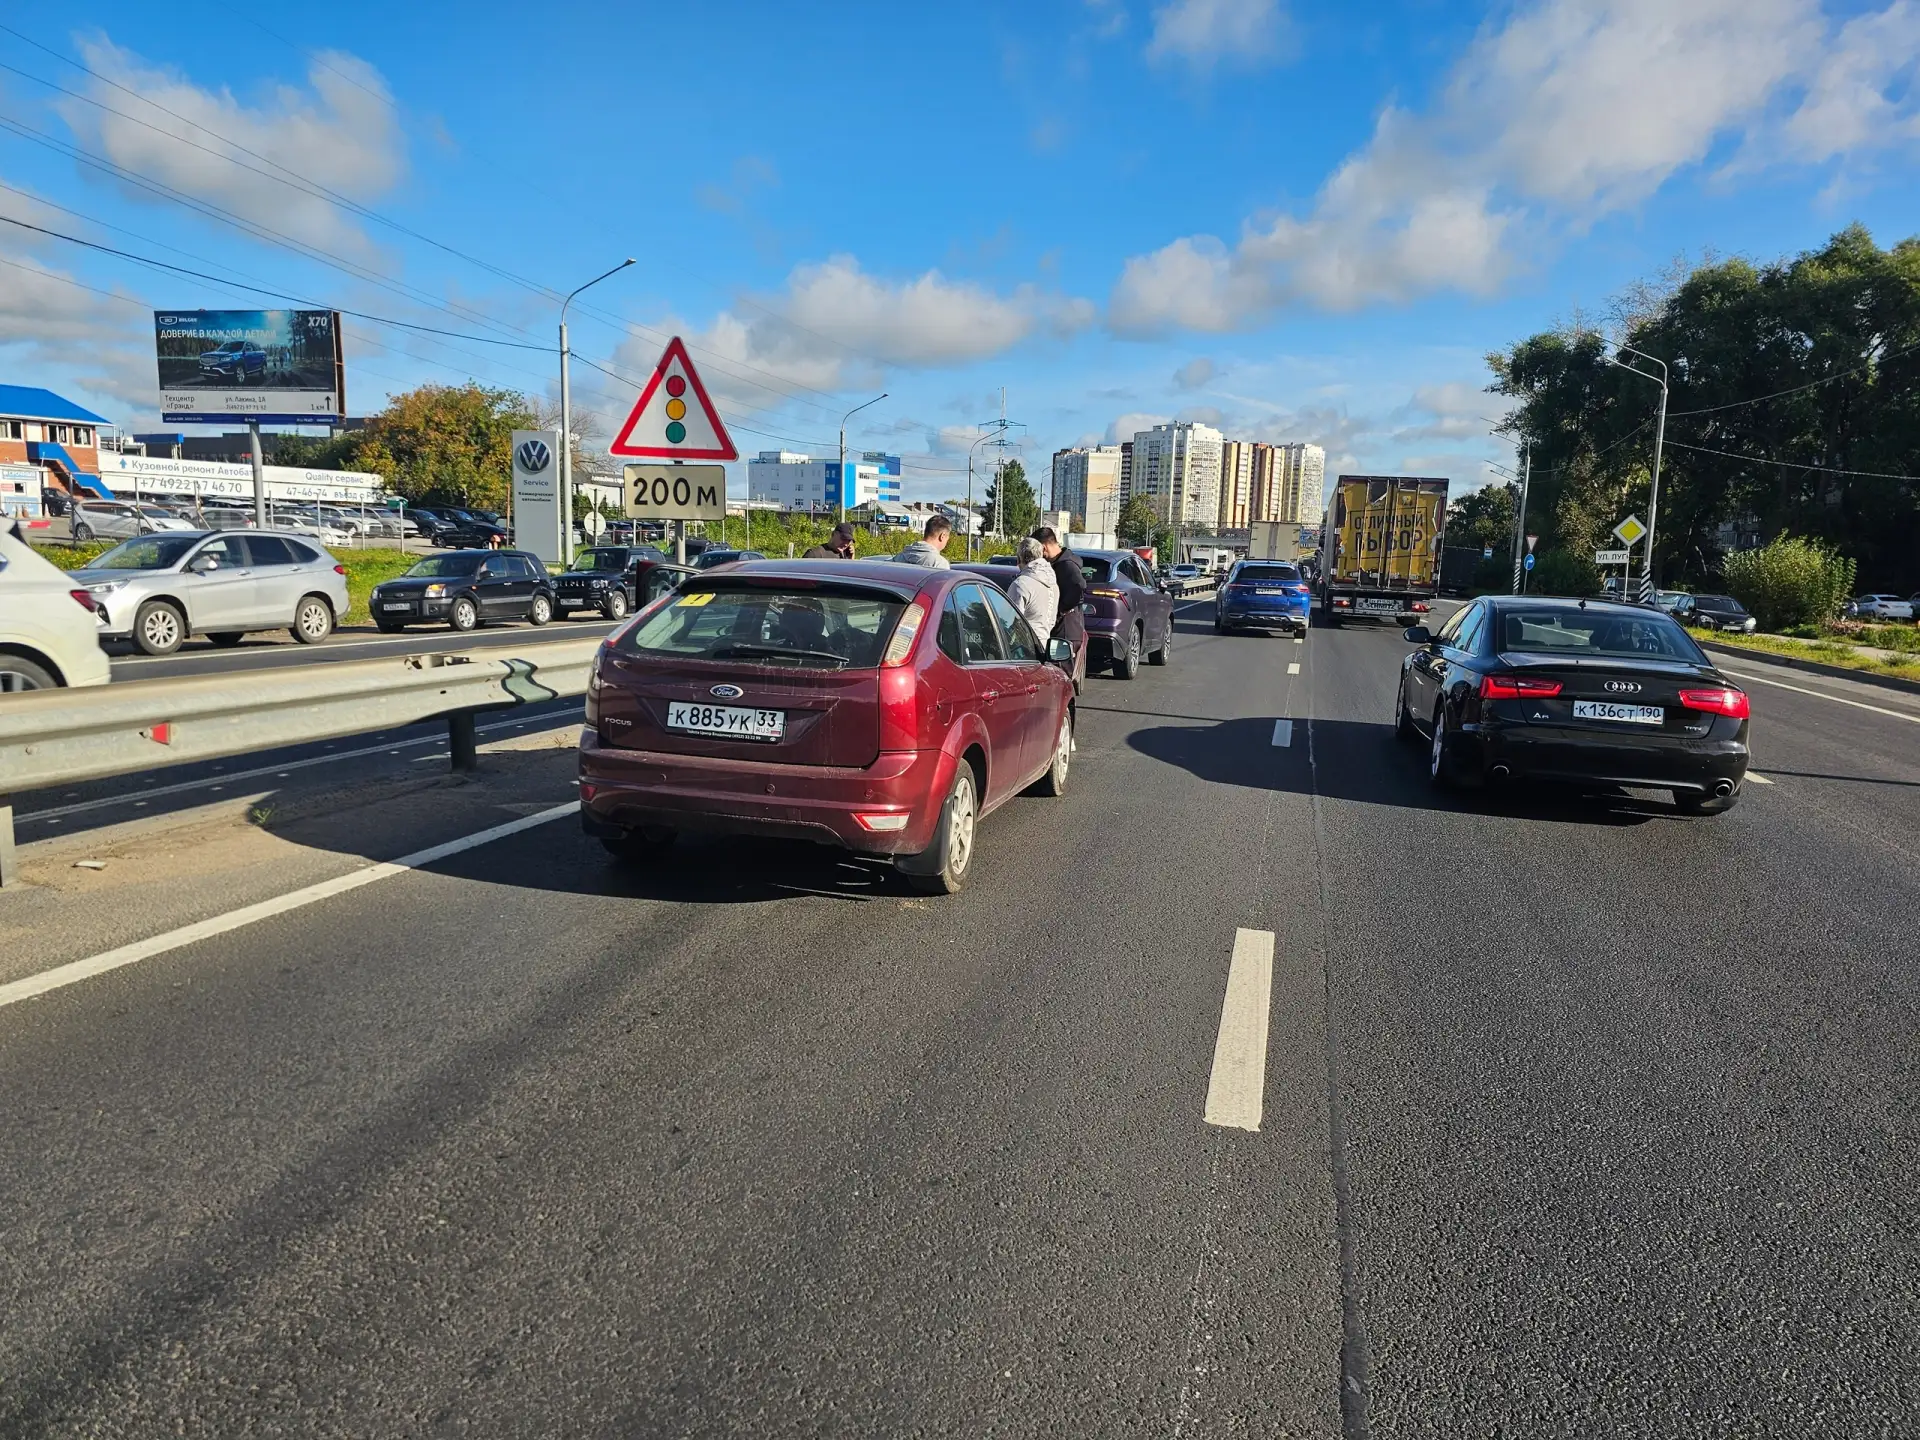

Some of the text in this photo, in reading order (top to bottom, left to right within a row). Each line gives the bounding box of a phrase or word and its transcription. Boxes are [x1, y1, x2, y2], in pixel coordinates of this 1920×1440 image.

[308, 317, 328, 327] X70
[160, 329, 197, 339] ДОВЕРИЕ
[200, 329, 205, 338] В
[206, 328, 243, 338] КАЖДОЙ
[165, 395, 195, 404] Техцентр
[132, 460, 180, 472] Кузовной
[182, 467, 215, 475] ремонт
[305, 472, 364, 484] Quality сервис
[140, 478, 156, 488] +7
[160, 478, 190, 489] 4922
[212, 482, 225, 492] 46
[229, 482, 242, 493] 70
[633, 477, 691, 506] 200
[287, 487, 328, 498] 47-46-74
[1355, 510, 1423, 530] ОТЛИЧНЫЙ
[716, 687, 734, 696] Ford
[1578, 704, 1661, 719] К136СТ 190
[605, 717, 632, 726] FOCUS
[675, 707, 777, 731] К885УК 33
